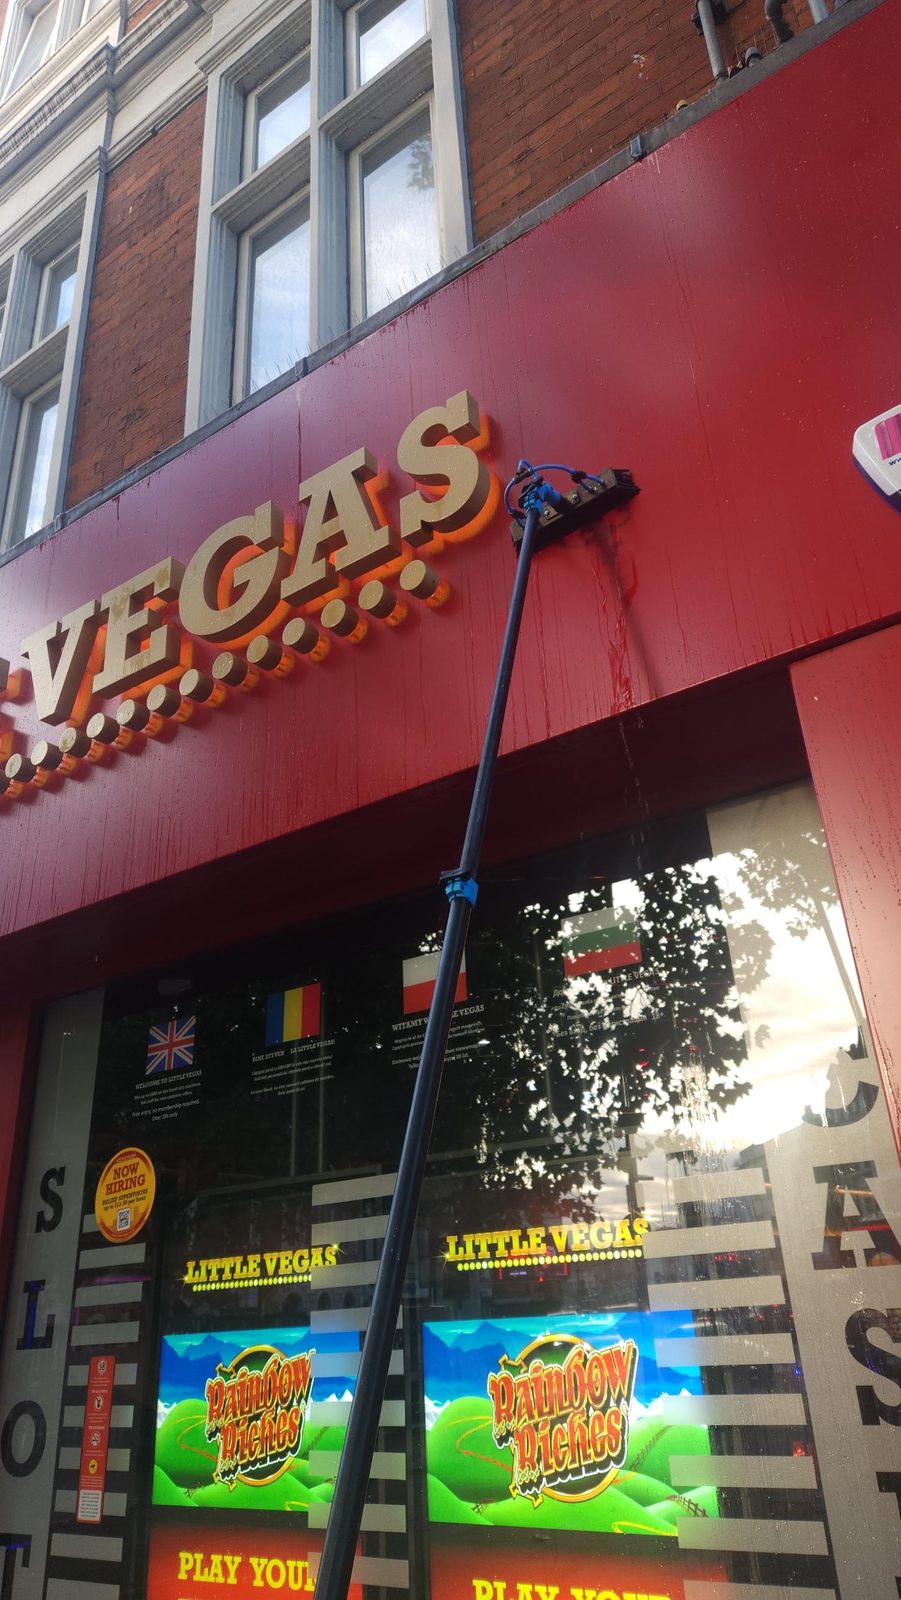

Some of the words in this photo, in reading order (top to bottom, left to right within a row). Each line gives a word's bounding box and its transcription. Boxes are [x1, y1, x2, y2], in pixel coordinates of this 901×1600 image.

[20, 390, 490, 725] VEGAS
[392, 1018, 423, 1031] WITAMY
[459, 1004, 485, 1016] VEGAS
[135, 1080, 160, 1089] WELCOME
[168, 1073, 186, 1082] LITTLE
[105, 1174, 145, 1195] HIRING
[113, 1162, 139, 1180] NOW
[447, 1227, 547, 1261] LITTLE
[549, 1217, 649, 1252] VEGAS
[185, 1254, 261, 1283] LITTLE
[263, 1246, 337, 1276] VEGAS
[178, 1551, 242, 1584] PLAY
